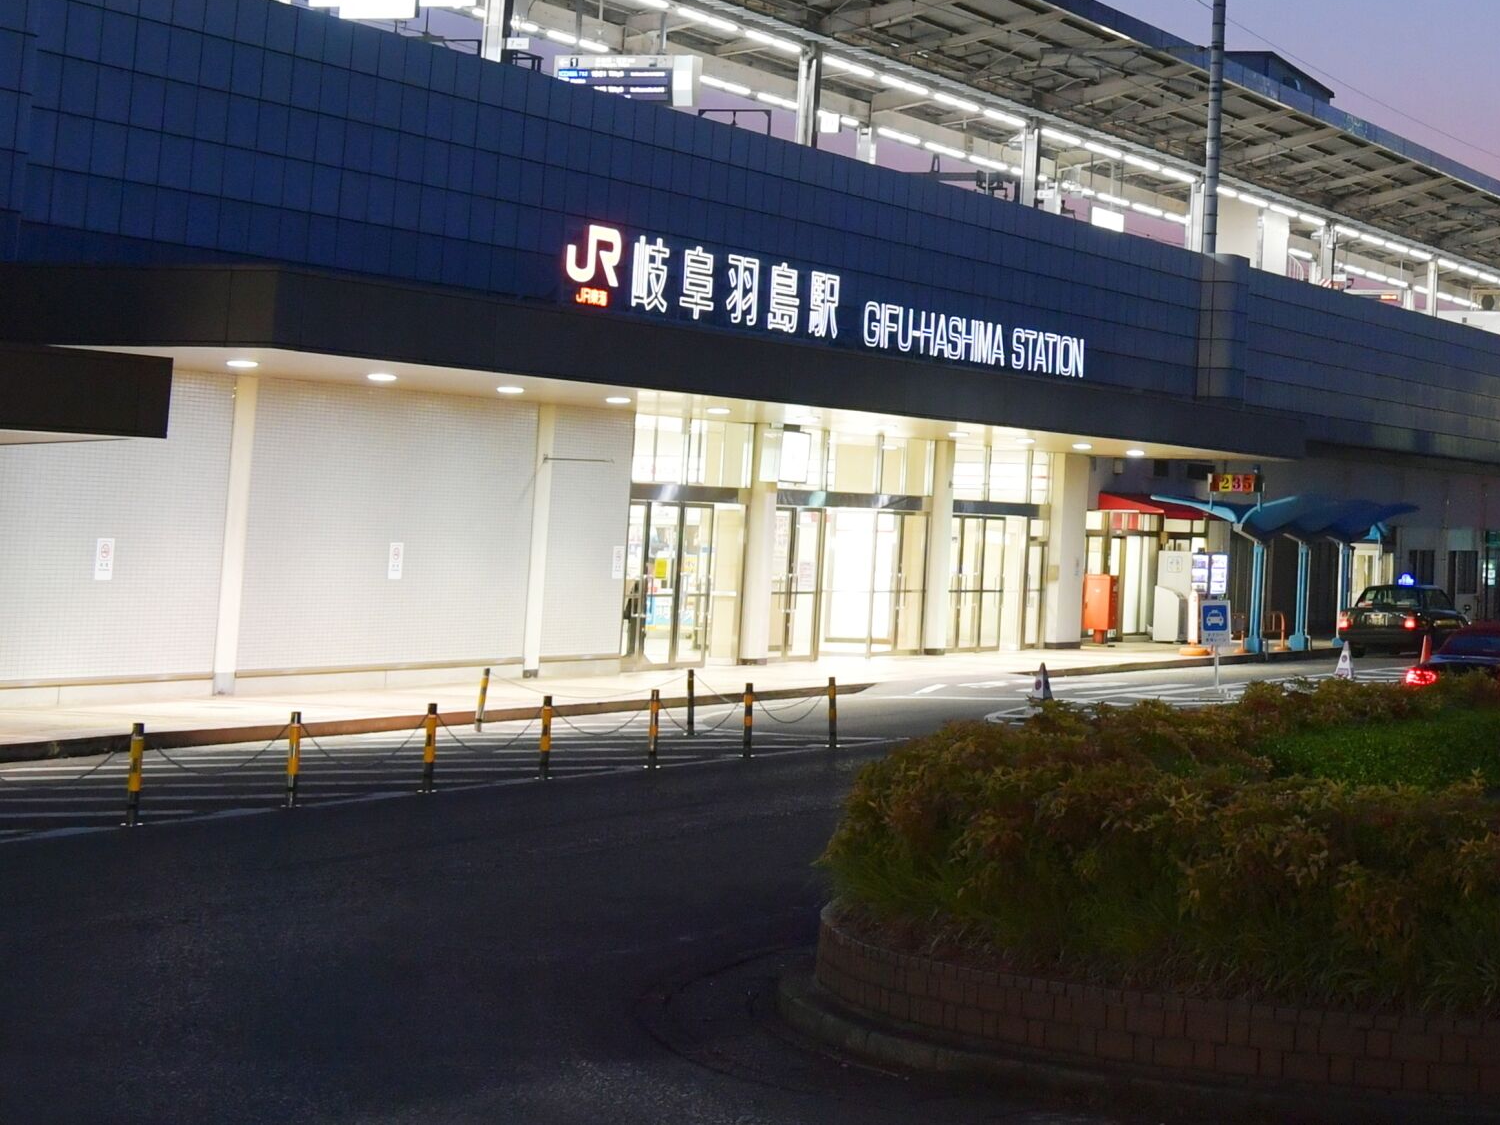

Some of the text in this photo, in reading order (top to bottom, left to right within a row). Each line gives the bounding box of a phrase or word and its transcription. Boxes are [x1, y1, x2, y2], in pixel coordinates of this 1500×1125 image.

[565, 224, 622, 288] JR
[631, 234, 841, 339] 岐阜羽島駅
[863, 301, 1085, 378] GIFU-HASHIMA STATION
